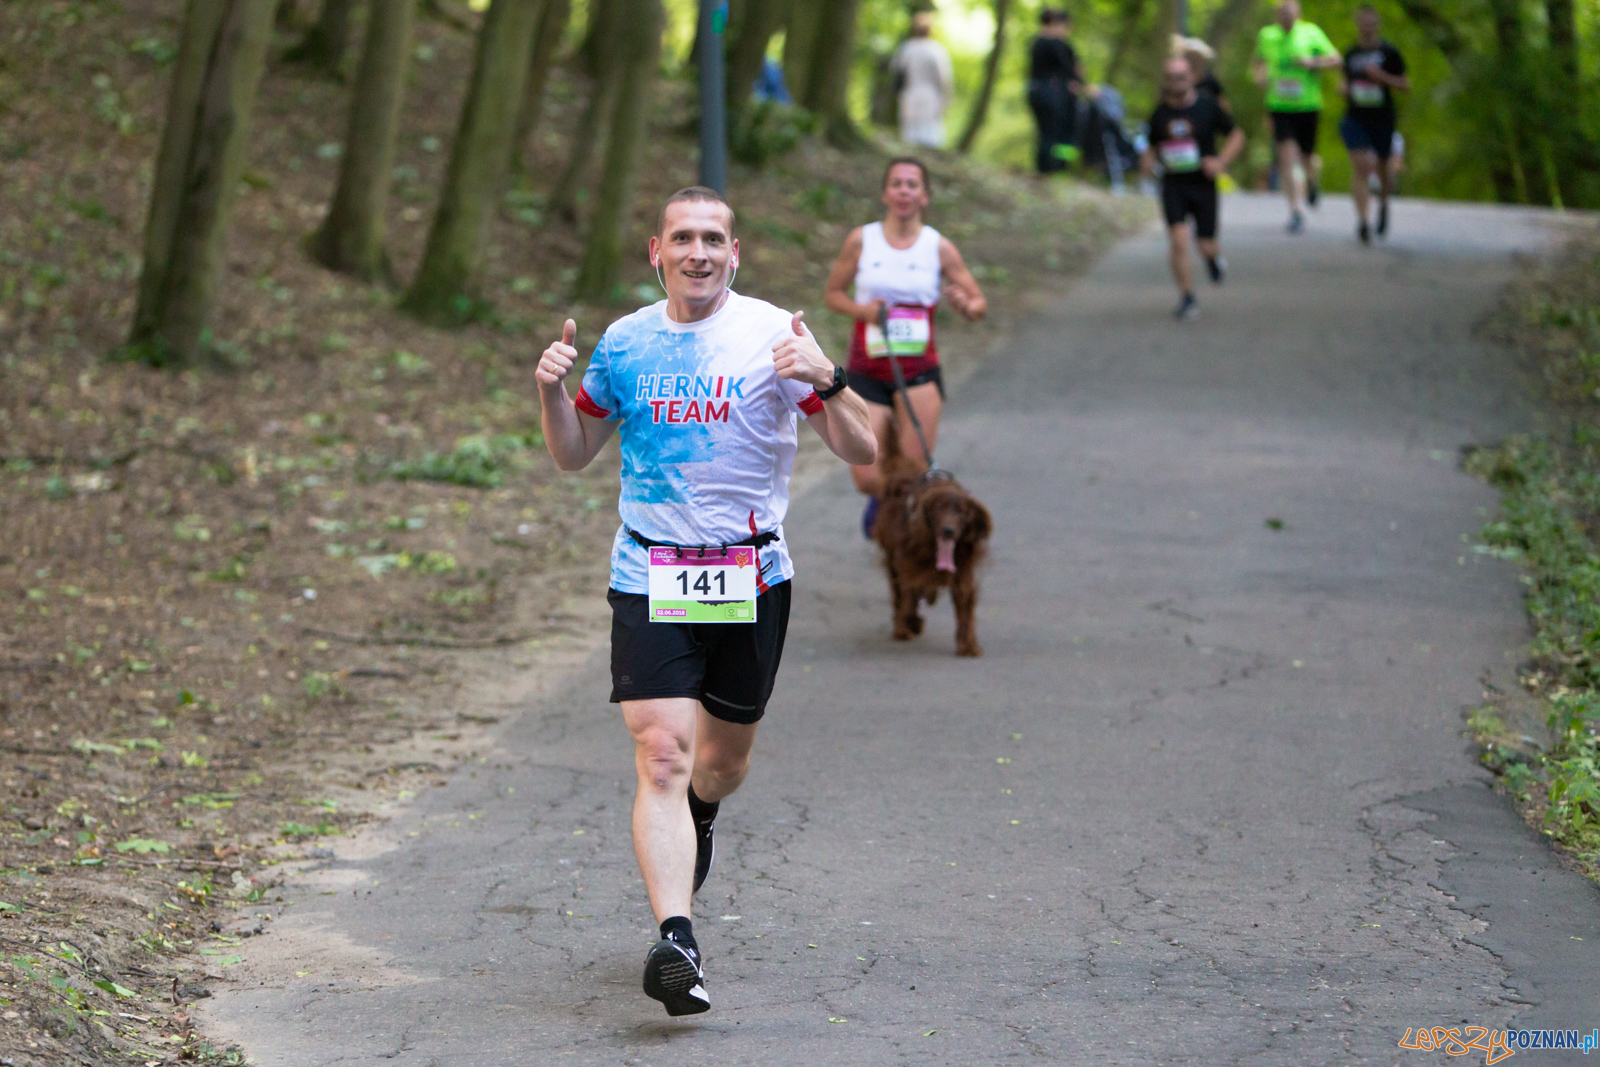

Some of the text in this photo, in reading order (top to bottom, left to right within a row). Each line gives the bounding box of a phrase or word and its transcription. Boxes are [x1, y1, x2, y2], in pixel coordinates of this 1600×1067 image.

[637, 375, 746, 399] HERNIK
[650, 401, 729, 423] TEAM
[677, 570, 725, 595] 141
